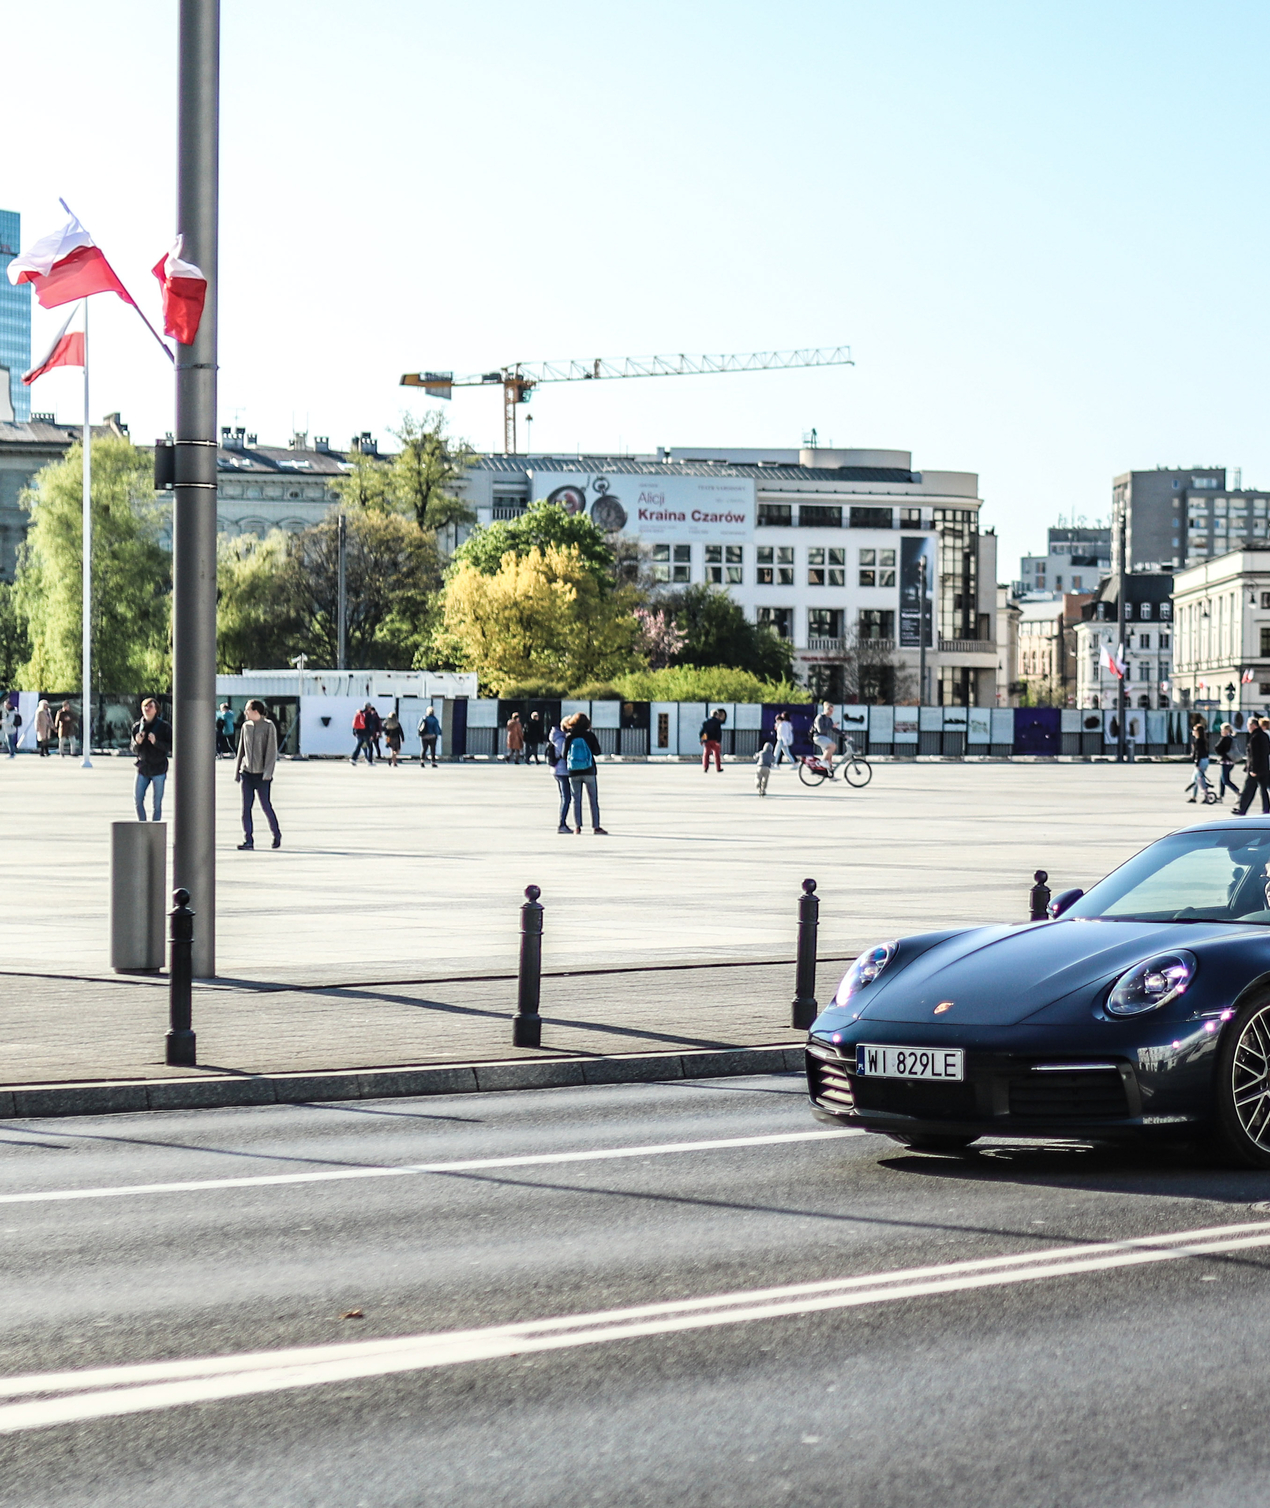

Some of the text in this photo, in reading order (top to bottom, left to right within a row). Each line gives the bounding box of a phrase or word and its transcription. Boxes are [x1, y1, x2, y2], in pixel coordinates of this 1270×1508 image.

[637, 491, 665, 507] Alicji
[638, 508, 746, 523] Kraina Czarów
[868, 1049, 956, 1077] WI 829LE
